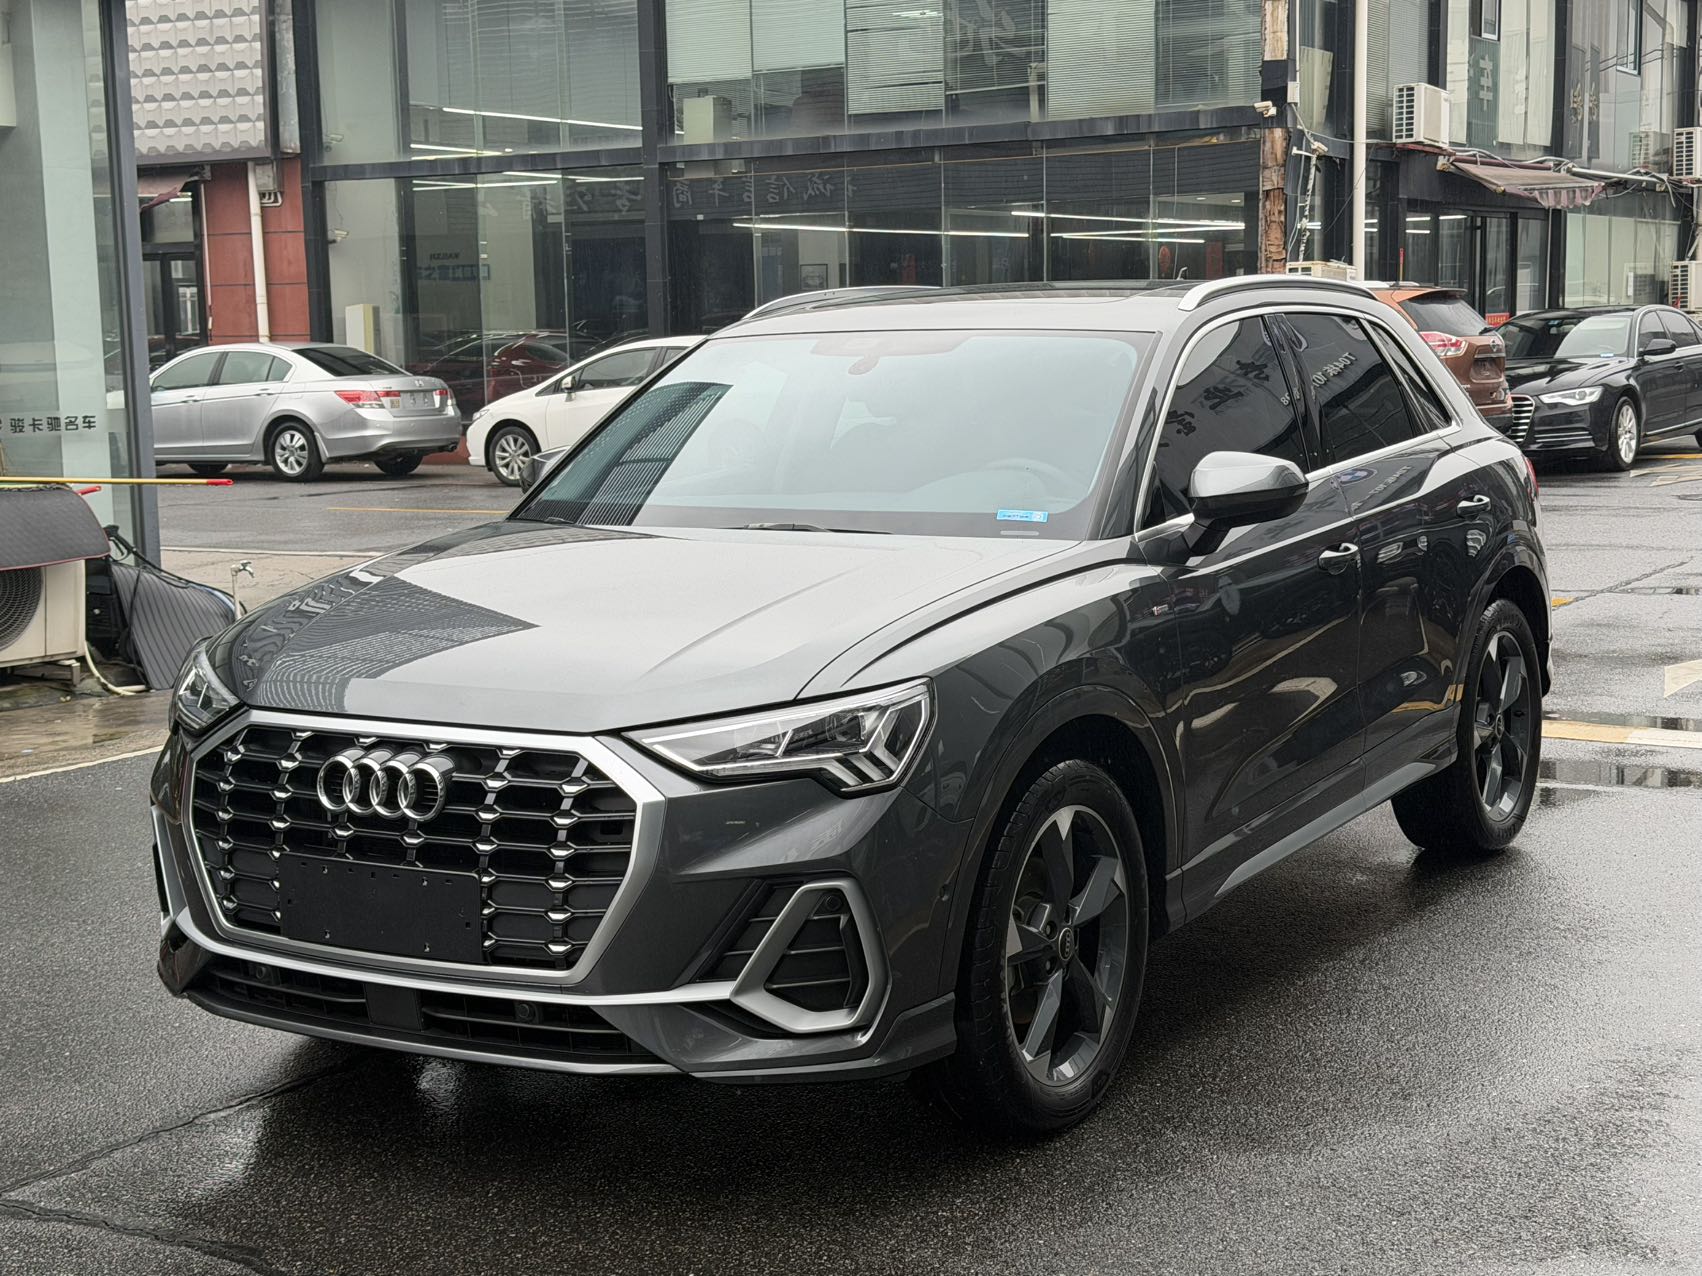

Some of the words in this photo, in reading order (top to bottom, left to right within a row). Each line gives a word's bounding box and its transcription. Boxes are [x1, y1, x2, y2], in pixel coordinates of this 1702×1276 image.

[9, 415, 97, 434] 骏卡驰名车
